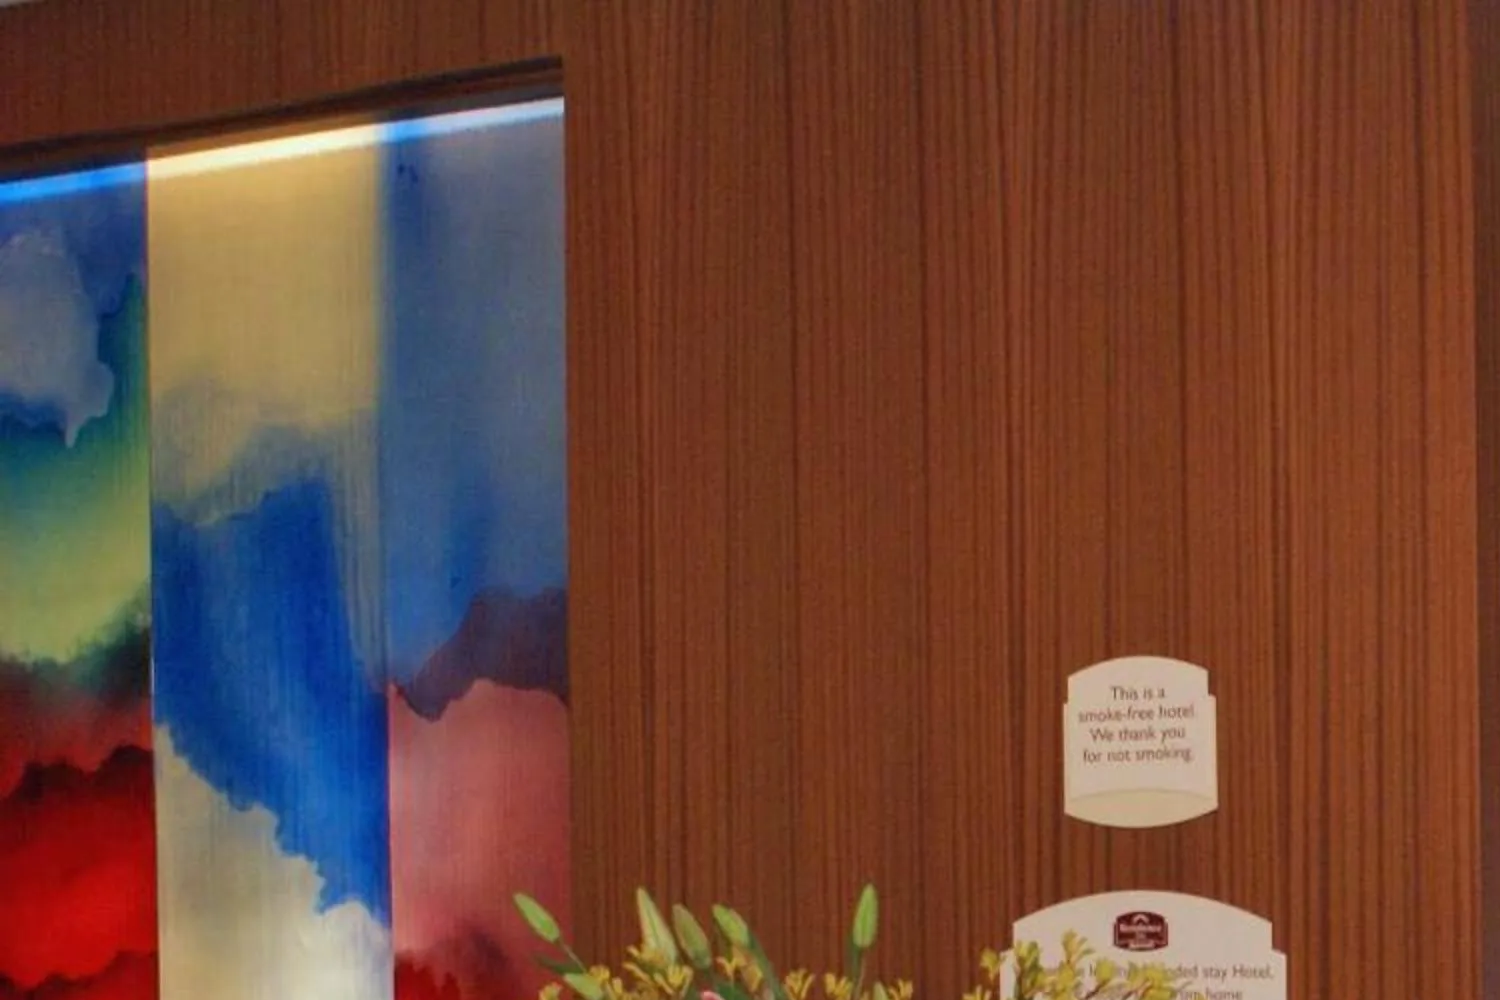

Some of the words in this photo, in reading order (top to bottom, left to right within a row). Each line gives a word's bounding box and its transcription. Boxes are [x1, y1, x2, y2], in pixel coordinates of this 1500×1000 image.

[1110, 685, 1139, 701] This
[1143, 686, 1153, 700] is
[1157, 687, 1166, 699] a
[1078, 706, 1155, 723] smoke-free
[1089, 727, 1115, 743] We
[1118, 725, 1156, 742] thank
[1161, 728, 1186, 745] you
[1083, 749, 1103, 764] for
[1107, 748, 1132, 763] not
[1201, 963, 1228, 983] stay
